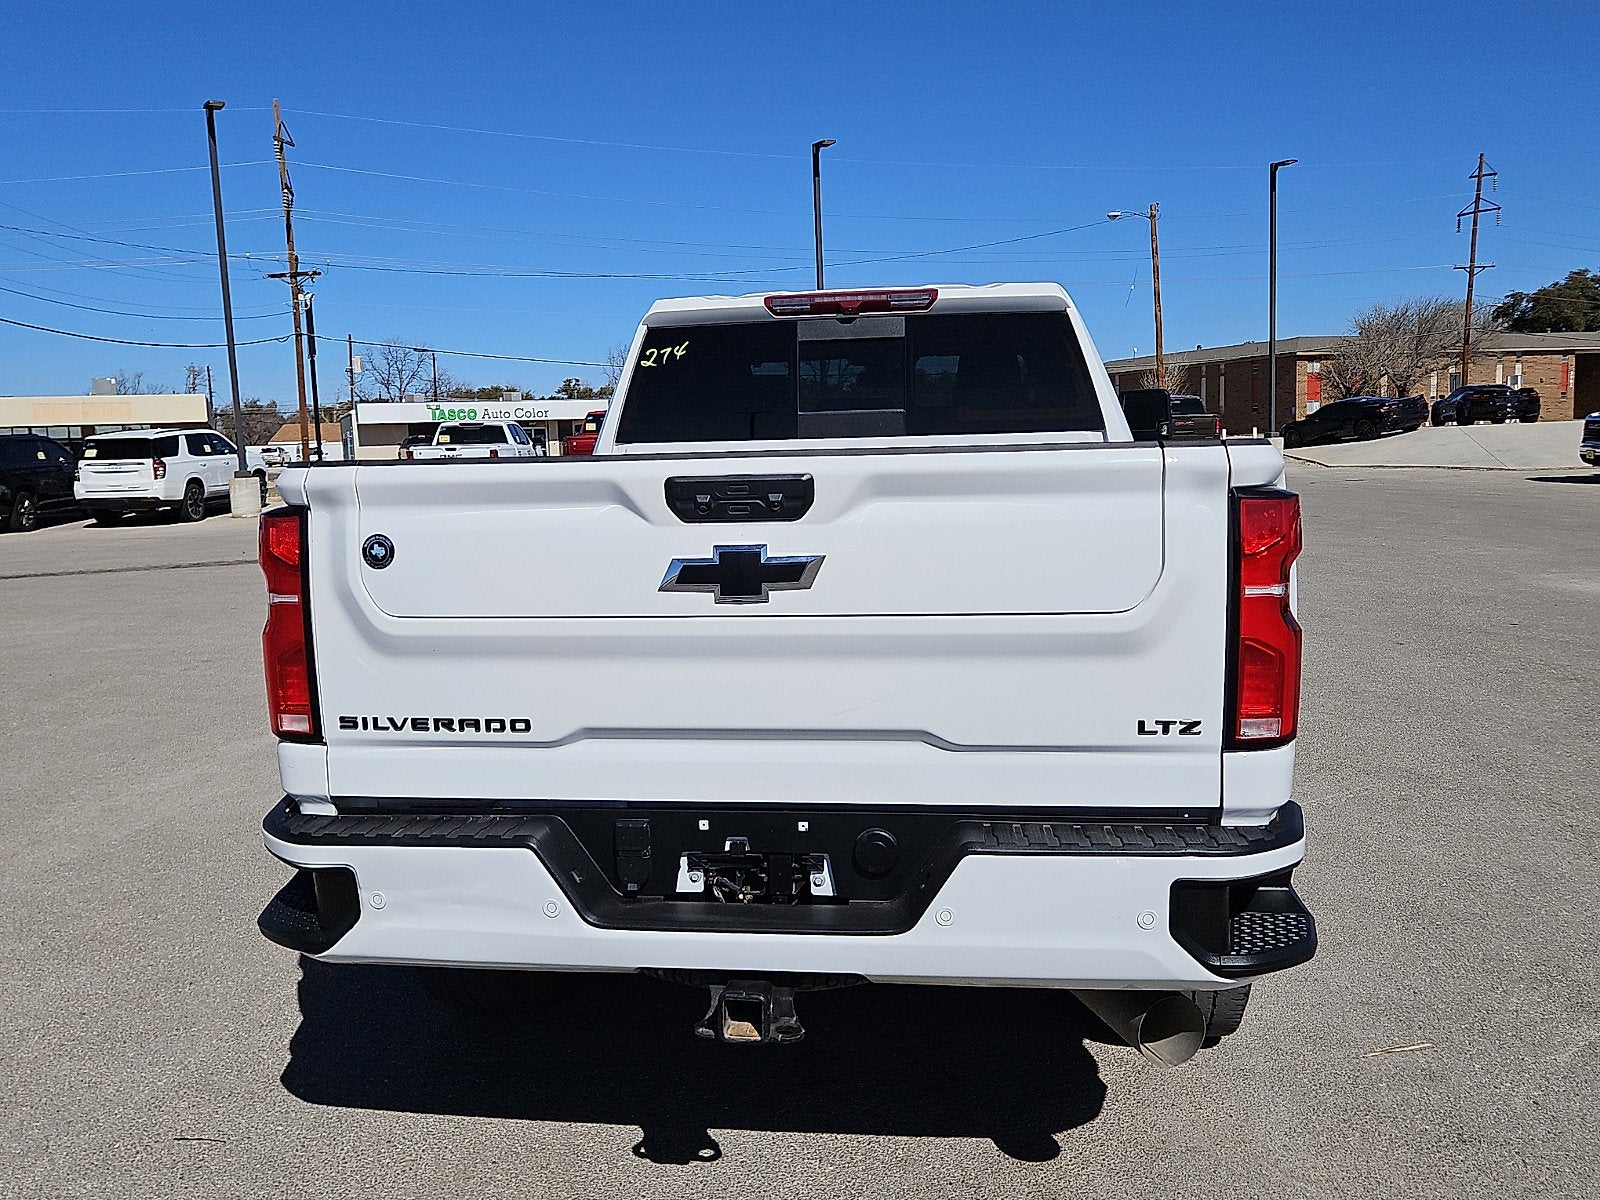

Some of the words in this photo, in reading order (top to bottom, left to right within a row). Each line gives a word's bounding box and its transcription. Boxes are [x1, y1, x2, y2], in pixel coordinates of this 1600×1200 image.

[640, 340, 690, 367] 274
[426, 404, 477, 421] TASCO
[481, 408, 511, 420] Auto
[514, 407, 550, 419] Color
[338, 715, 532, 734] SILVERADO
[1137, 719, 1202, 736] LTZ
